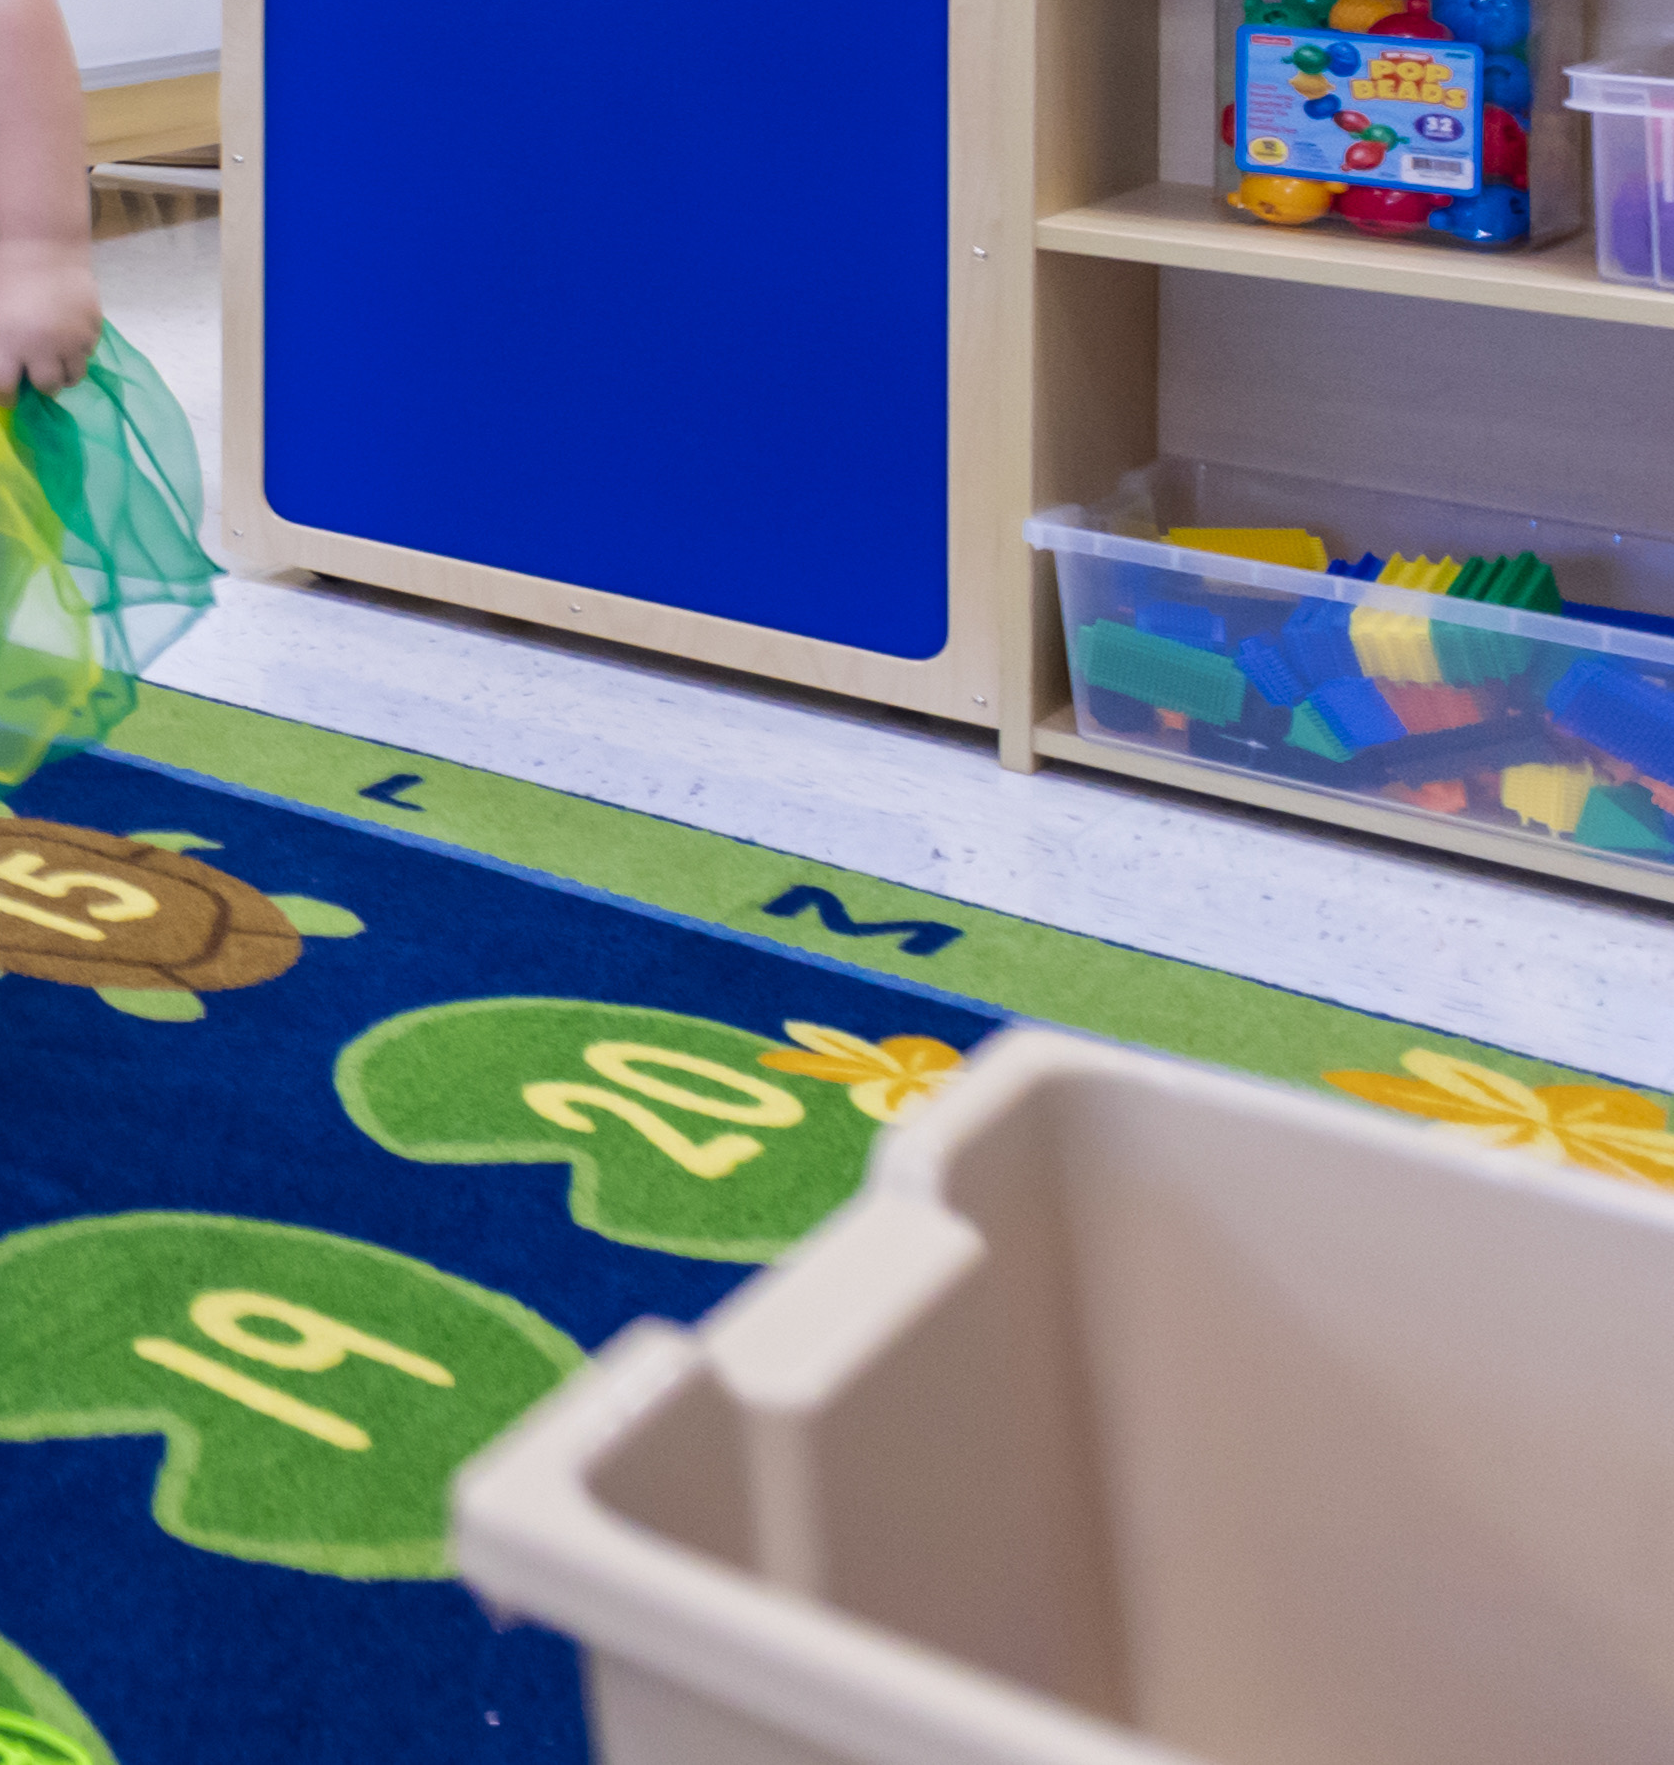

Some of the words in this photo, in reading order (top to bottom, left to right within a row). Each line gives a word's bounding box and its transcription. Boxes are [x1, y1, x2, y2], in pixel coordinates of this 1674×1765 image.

[1350, 79, 1468, 110] BEADS
[1369, 59, 1453, 83] POP
[1426, 117, 1453, 132] 32
[762, 884, 967, 956] M
[522, 1041, 806, 1178] 20
[133, 1291, 455, 1451] 19
